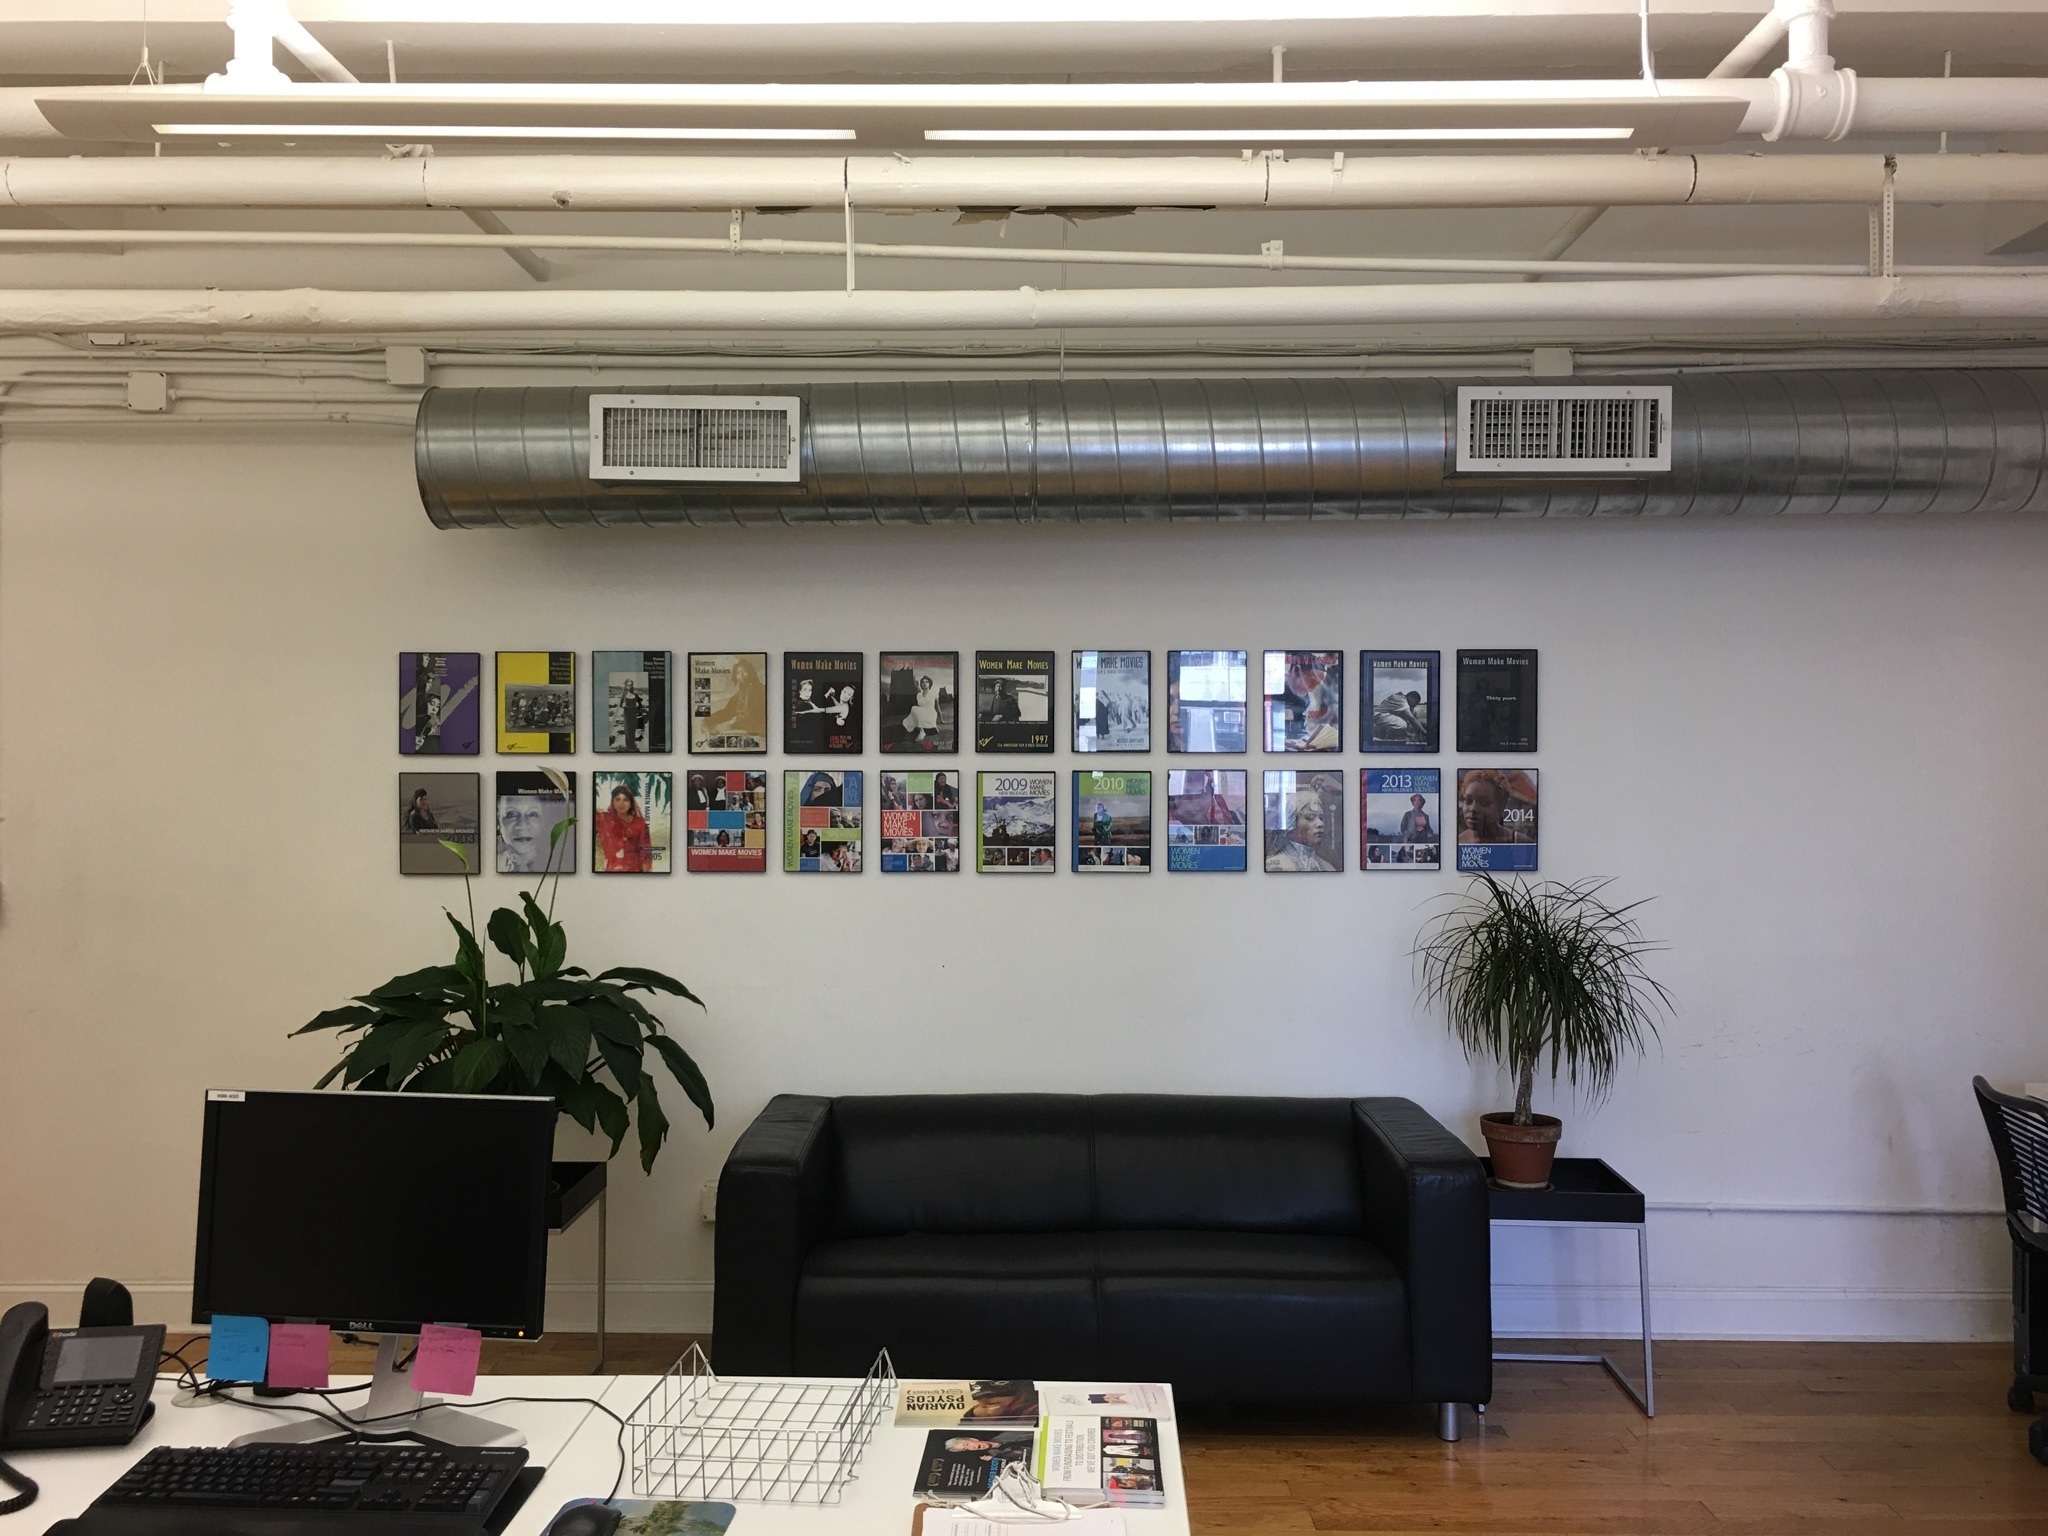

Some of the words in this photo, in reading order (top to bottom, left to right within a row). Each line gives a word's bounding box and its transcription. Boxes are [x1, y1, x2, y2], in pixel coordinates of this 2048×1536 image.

[790, 660, 813, 670] Women
[816, 660, 832, 670] Make
[835, 660, 857, 670] Movies
[1006, 660, 1023, 670] MAKE
[1027, 660, 1048, 670] MOVIES
[1100, 656, 1118, 668] MAKE
[1120, 656, 1144, 668] MOVIES
[1031, 735, 1048, 744] 1997
[995, 778, 1027, 790] 2009
[1093, 777, 1124, 790] 2010
[1382, 774, 1412, 788] 2013
[884, 812, 916, 820] WOMEN
[1503, 809, 1534, 822] 2014
[884, 828, 914, 836] MOVIES
[644, 852, 662, 860] 2005
[1170, 847, 1200, 855] WOMEN
[350, 1322, 374, 1330] DELL
[906, 1395, 964, 1403] PSYCOS
[906, 1402, 965, 1410] OVARIAN
[1054, 1428, 1062, 1443] MOVIES
[1052, 1456, 1060, 1472] WOMEN
